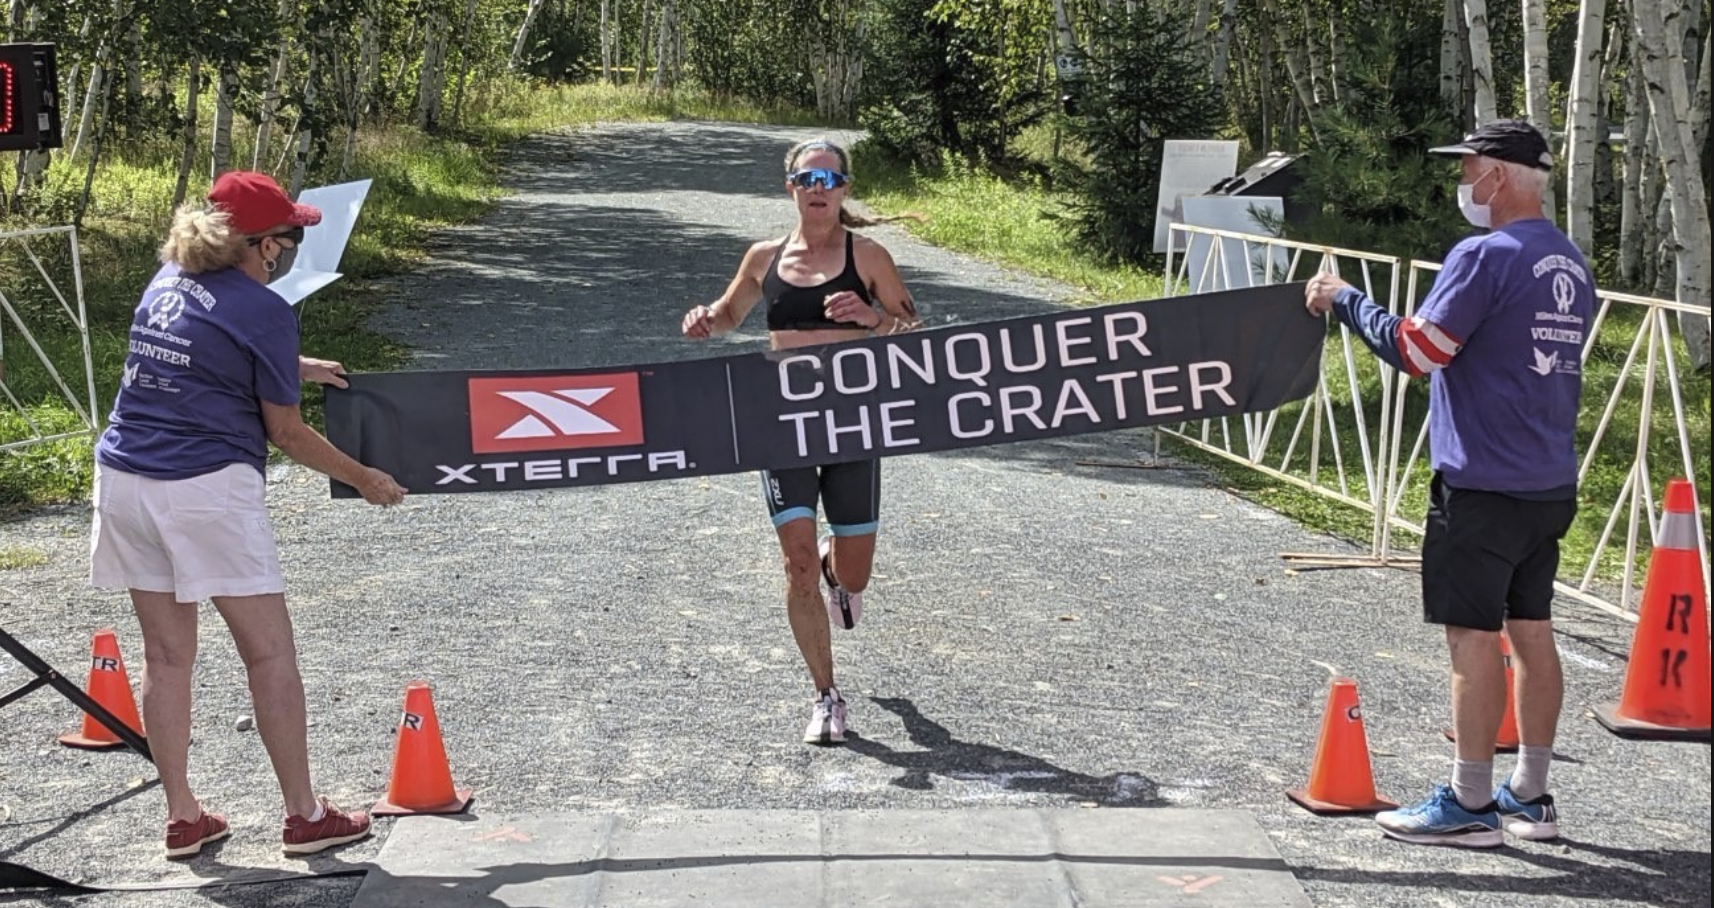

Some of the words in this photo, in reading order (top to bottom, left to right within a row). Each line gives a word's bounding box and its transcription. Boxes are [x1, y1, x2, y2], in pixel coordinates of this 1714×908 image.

[163, 332, 192, 347] Cancer
[778, 311, 1152, 401] CONQUER
[778, 400, 921, 457] THE
[947, 360, 1237, 440] CRATER
[770, 478, 785, 506] 2XU
[1665, 593, 1693, 635] R
[1659, 648, 1688, 689] K
[404, 713, 420, 731] R
